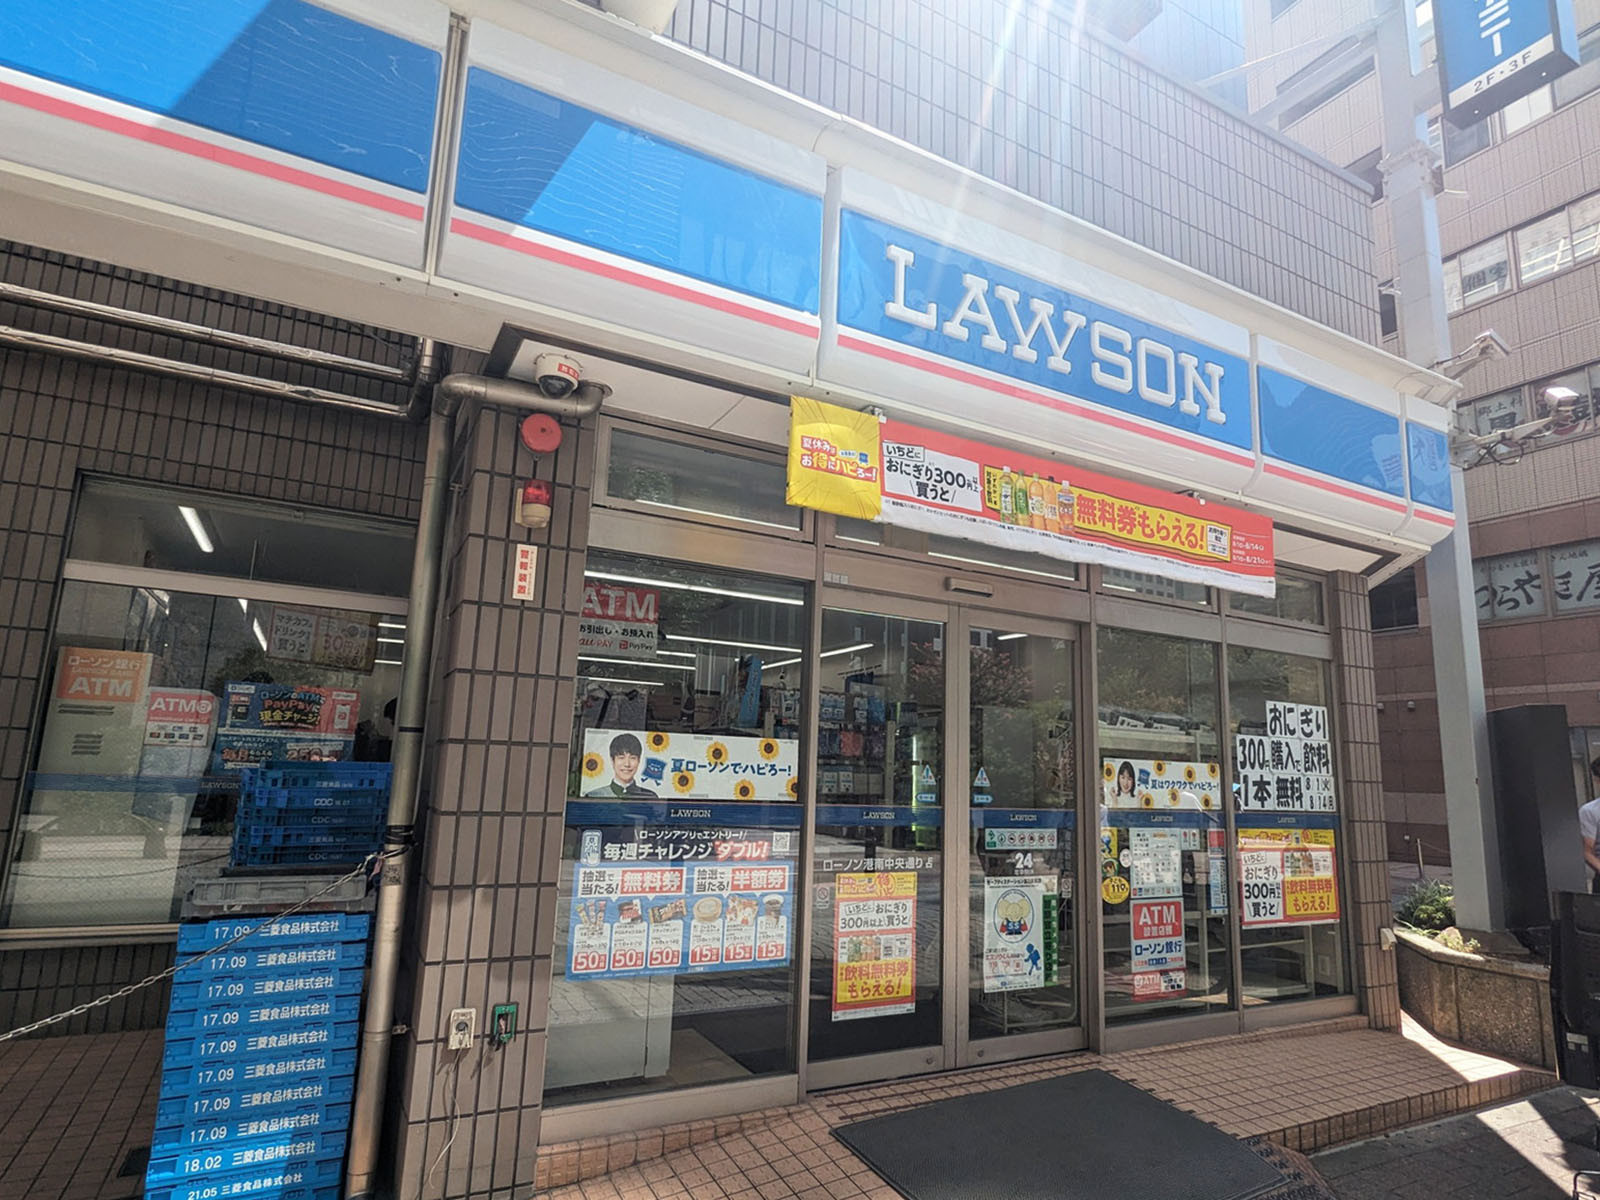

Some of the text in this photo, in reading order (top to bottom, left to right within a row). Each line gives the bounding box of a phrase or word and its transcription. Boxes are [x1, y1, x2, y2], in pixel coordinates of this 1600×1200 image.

[885, 244, 1226, 425] LAWSON
[886, 445, 921, 459] いちどに
[916, 481, 950, 502] 買うと
[1077, 494, 1205, 550] 無料券もらえる!
[583, 586, 656, 620] ATM
[68, 655, 141, 671] ローソン銀行
[68, 676, 133, 697] ATM
[151, 697, 196, 713] ATM
[264, 700, 320, 713] PayPayに
[259, 709, 321, 725] 現金チャージ!
[1269, 703, 1326, 739] おにぎり
[671, 758, 792, 777] 夏ローソンでハピろー!
[1243, 774, 1304, 809] 1本無料
[670, 808, 712, 818] LAWSON
[863, 811, 896, 820] LAWSON
[640, 830, 744, 840] ローソンアプリでエントリー!
[1015, 853, 1033, 868] 24
[582, 870, 681, 892] 抽選で 無料券
[733, 869, 785, 889] 半額券
[1245, 865, 1278, 881] おにぎり
[581, 883, 619, 896] 当たる!
[696, 881, 730, 893] 当たる!
[1244, 883, 1282, 899] 300円以上
[1289, 879, 1333, 895] 飲料無料券
[875, 903, 908, 914] おにぎり
[1252, 902, 1276, 917] 買うと
[1293, 895, 1331, 912] もらえる!
[886, 915, 908, 927] 買うと
[1139, 905, 1176, 925] ATM
[213, 920, 340, 939] 17.09 三菱食品株式会社
[1135, 941, 1183, 956] ローソン銀行
[210, 949, 337, 970] 17.09 三菱食品株式会社
[845, 961, 909, 981] 飲料無料券
[207, 977, 334, 998] 17.09 三菱食品株式会社
[848, 978, 902, 998] もらえる!
[202, 1003, 330, 1026] 17.09 三菱食品株式会社
[200, 1030, 328, 1055] 17.09 三菱食品株式会社
[197, 1058, 326, 1084] 17.09 三菱食品株式会社
[194, 1085, 323, 1113] 17.09 三菱食品株式会社
[190, 1114, 320, 1143] 17.09 三菱食品株式会社
[183, 1142, 316, 1172] 18.02 三菱食品株式会社
[187, 1173, 303, 1200] 21.05 三菱食品株式会社
